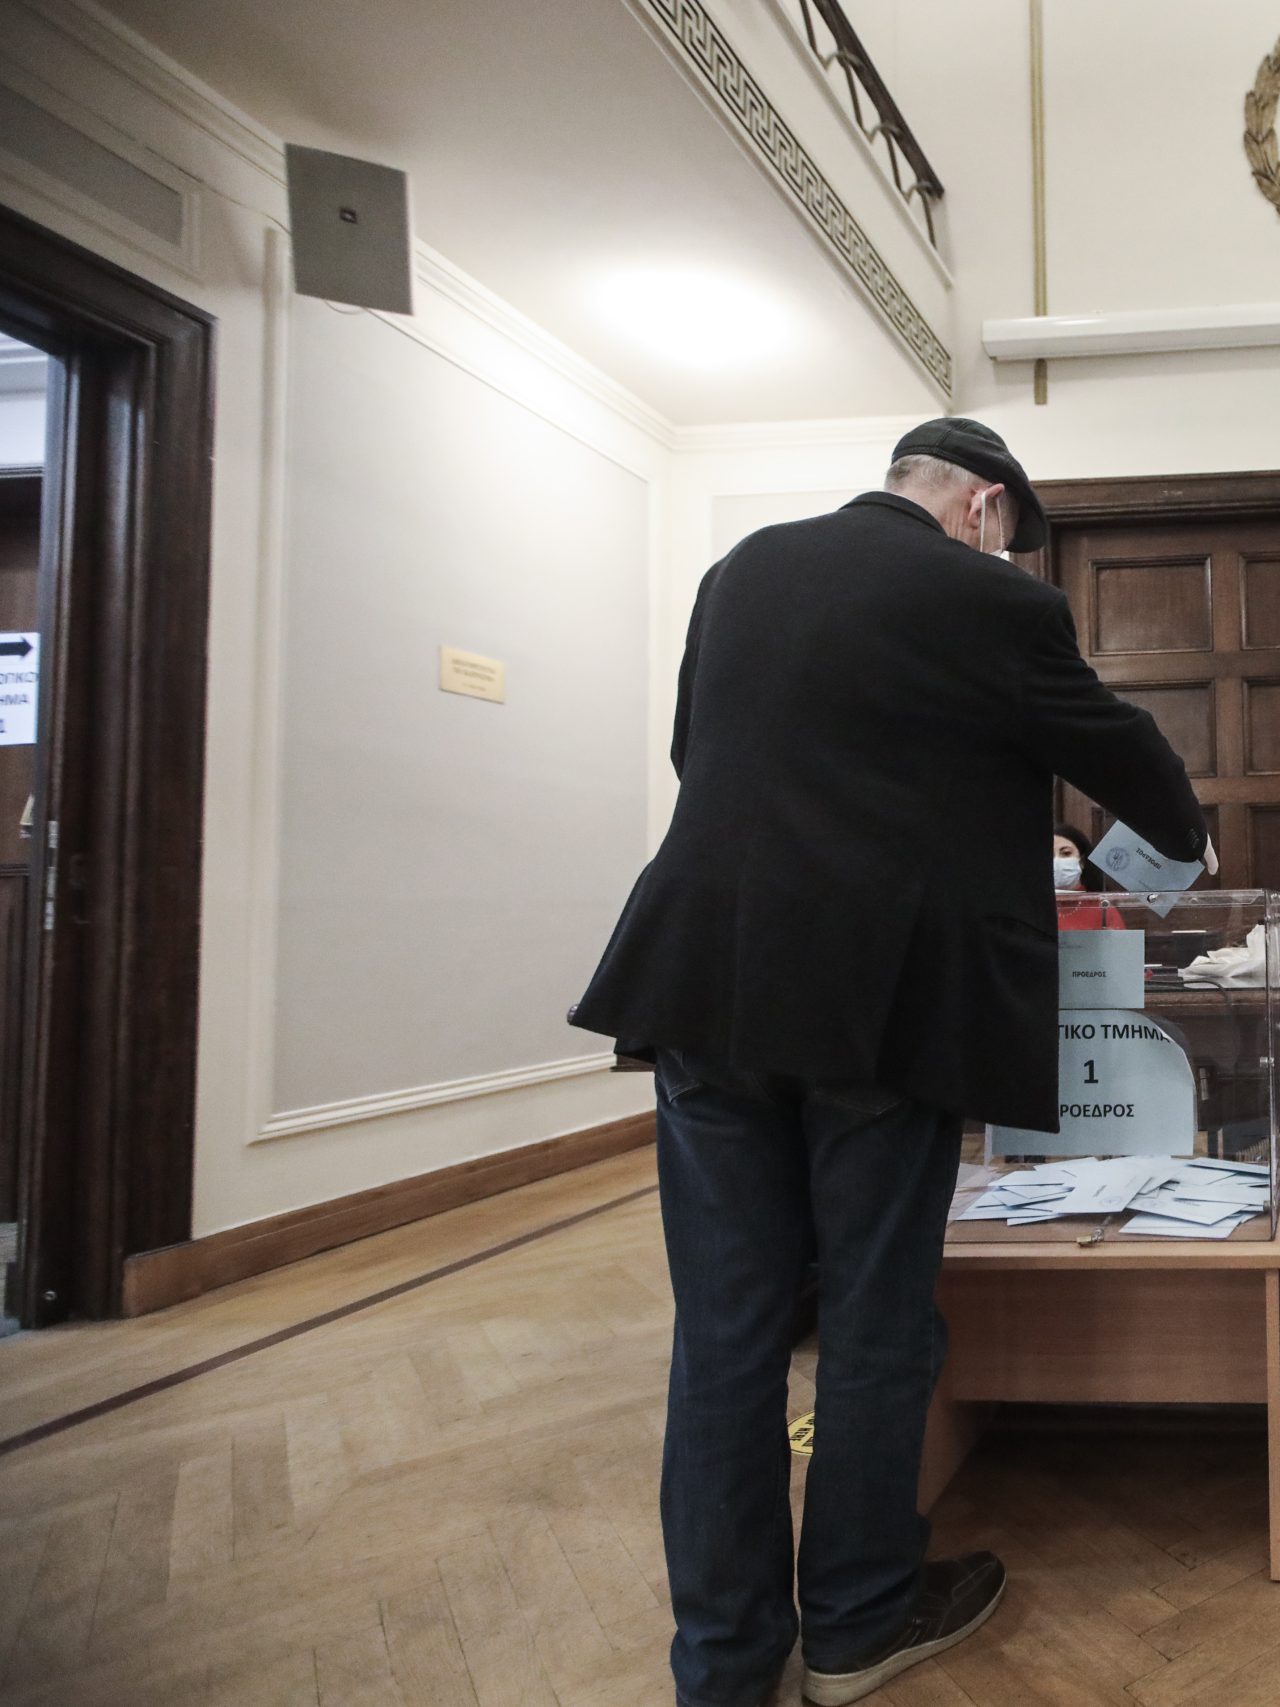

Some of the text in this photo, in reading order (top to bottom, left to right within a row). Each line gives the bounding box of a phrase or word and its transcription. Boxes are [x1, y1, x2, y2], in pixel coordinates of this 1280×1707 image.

[1072, 970, 1106, 978] ΠΡΟΕΔΡΟΣ
[1058, 1024, 1096, 1040] ΓΙΚΟ
[1083, 1059, 1099, 1084] 1
[1059, 1104, 1135, 1118] ΡΟΕΔΡΟΣ
